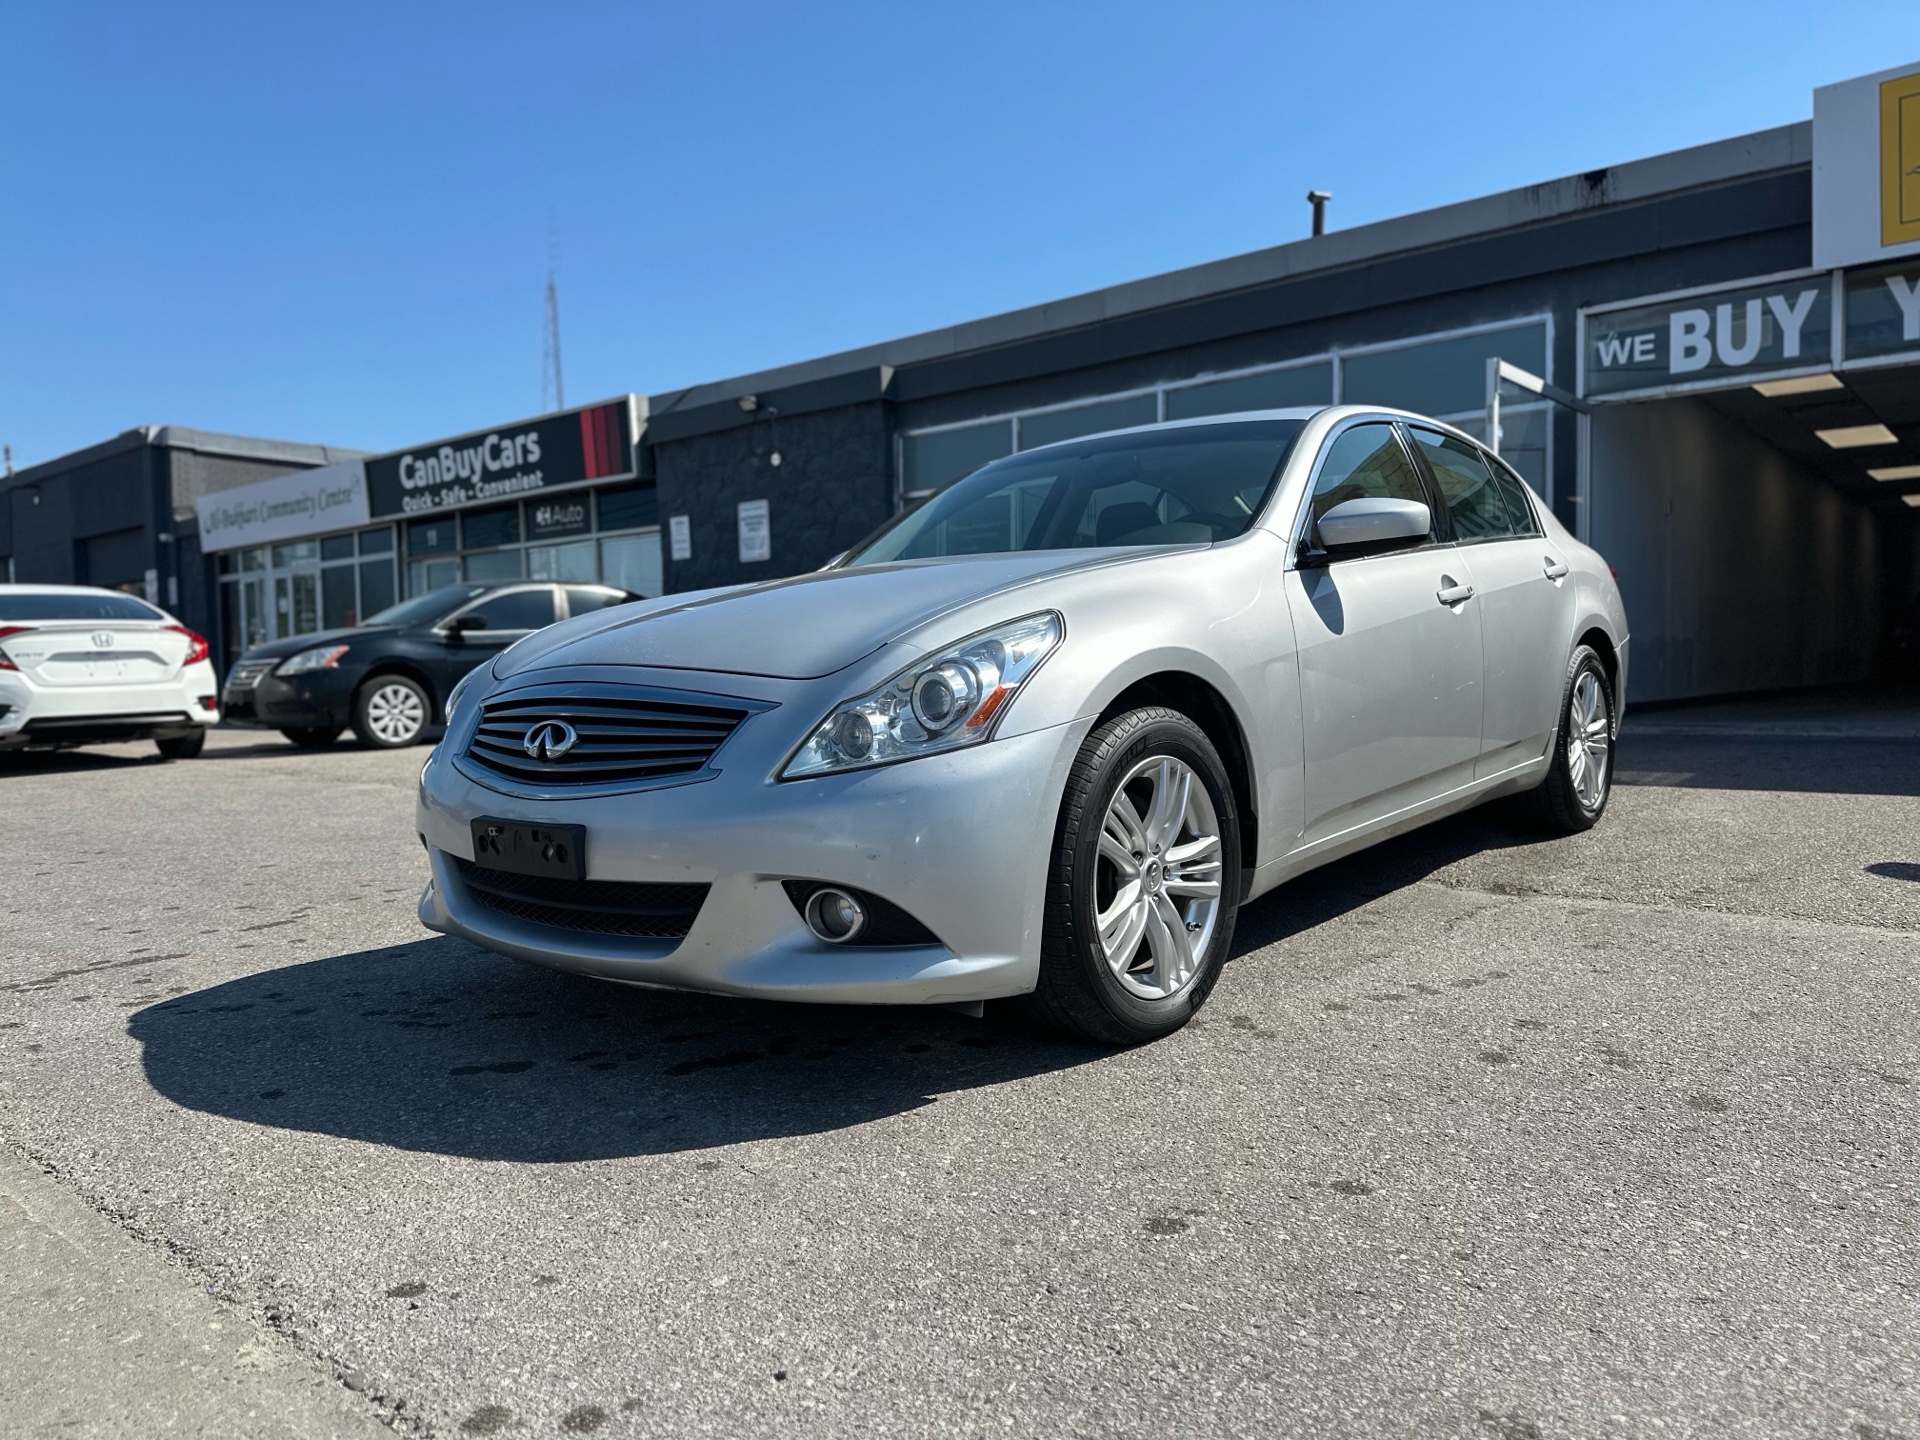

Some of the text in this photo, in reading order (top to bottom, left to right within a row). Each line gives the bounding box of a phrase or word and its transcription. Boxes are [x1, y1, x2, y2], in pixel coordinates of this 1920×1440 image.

[1597, 333, 1656, 367] WE
[1669, 289, 1819, 375] BUY
[399, 431, 542, 490] CanBuyCars
[260, 492, 316, 521] Community
[403, 470, 544, 512] Quick Safe Convenient
[553, 505, 584, 523] Auto
